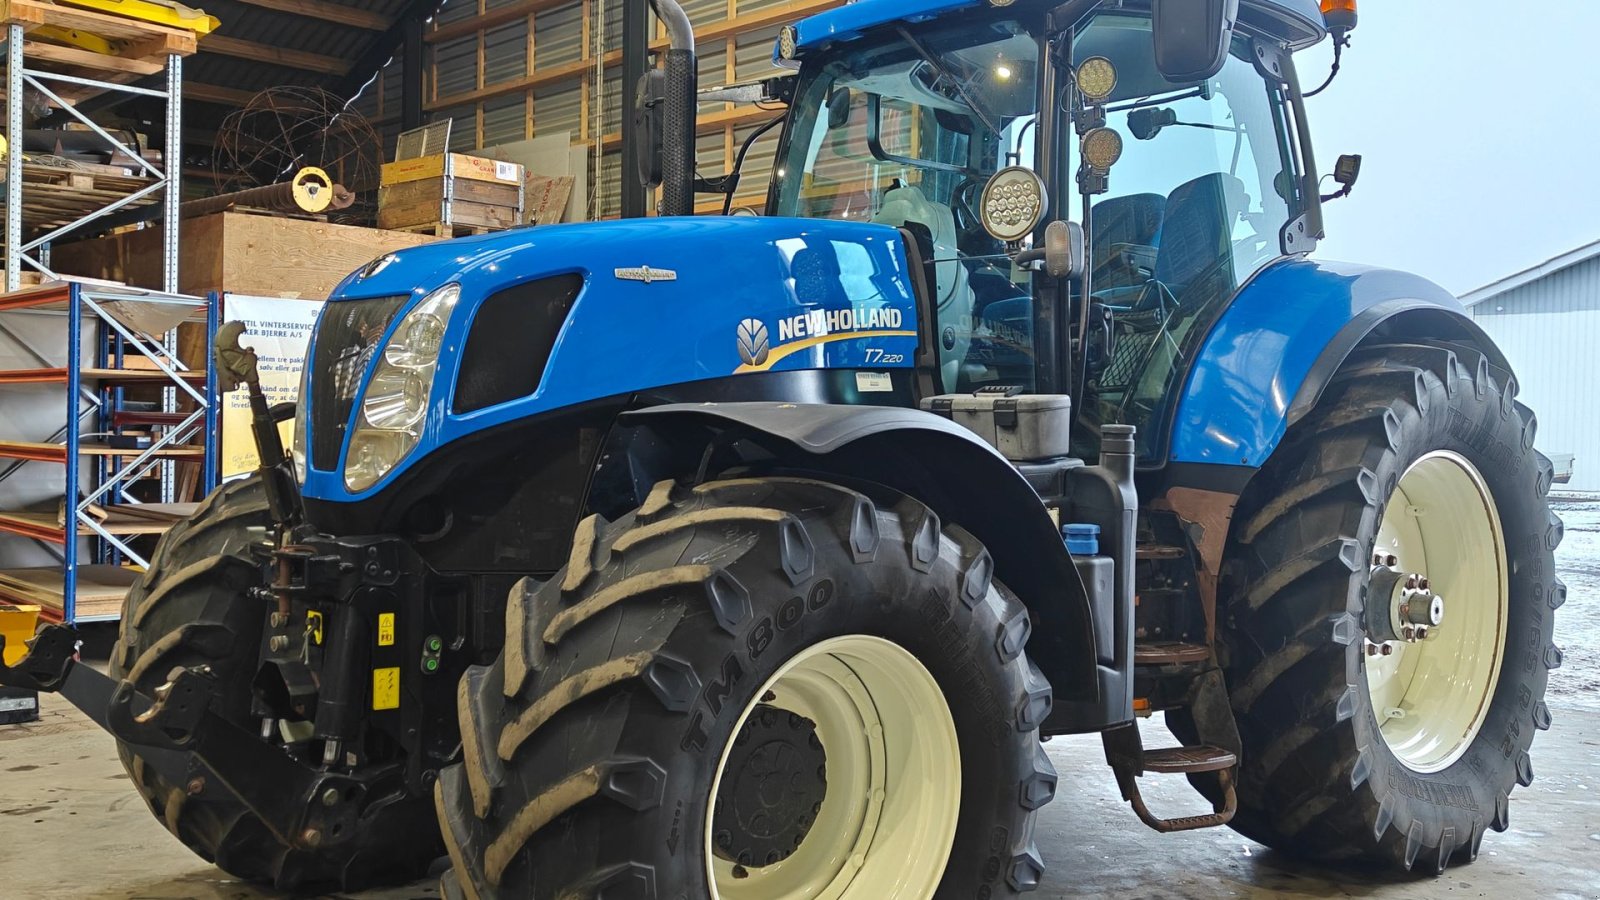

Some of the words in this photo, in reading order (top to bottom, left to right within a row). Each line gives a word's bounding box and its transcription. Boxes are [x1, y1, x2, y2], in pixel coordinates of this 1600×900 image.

[779, 309, 827, 341] NEW
[826, 308, 902, 331] HOLLAND
[864, 348, 903, 363] T7.220
[680, 654, 745, 753] TM
[746, 577, 834, 661] 800
